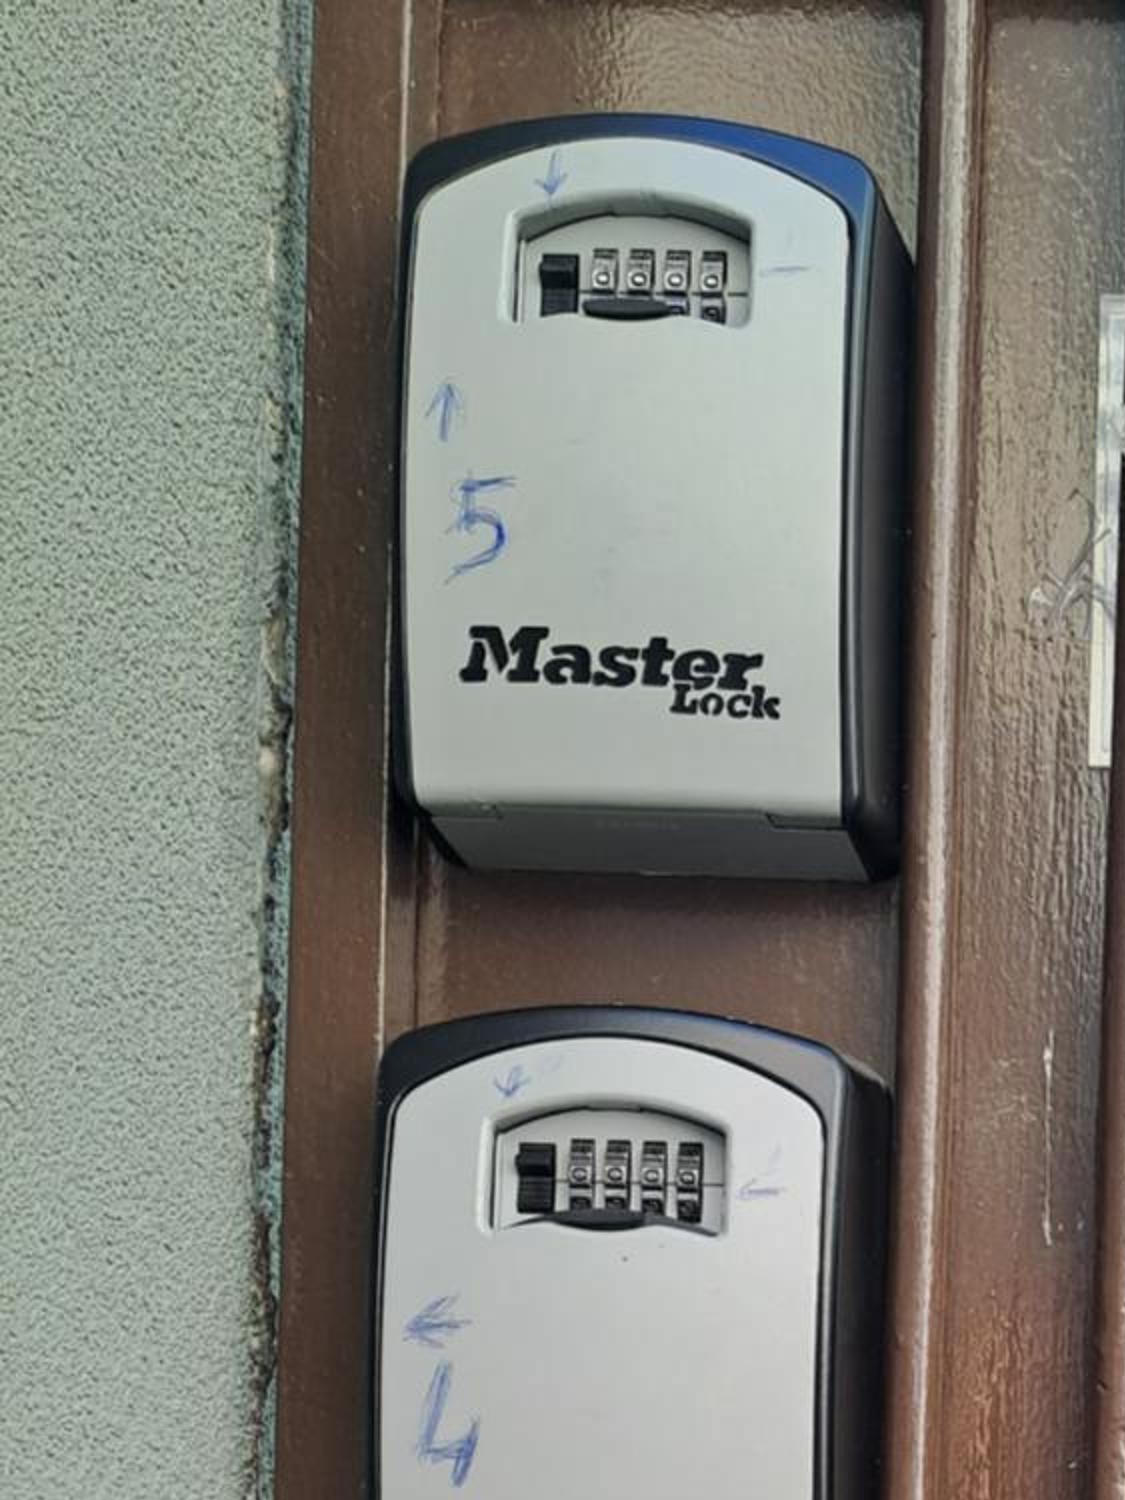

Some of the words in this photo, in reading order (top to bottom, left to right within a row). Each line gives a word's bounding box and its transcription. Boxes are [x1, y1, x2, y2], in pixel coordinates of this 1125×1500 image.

[446, 470, 515, 585] 5
[460, 626, 764, 691] Master
[669, 684, 780, 720] Lock
[416, 1360, 480, 1487] 4
